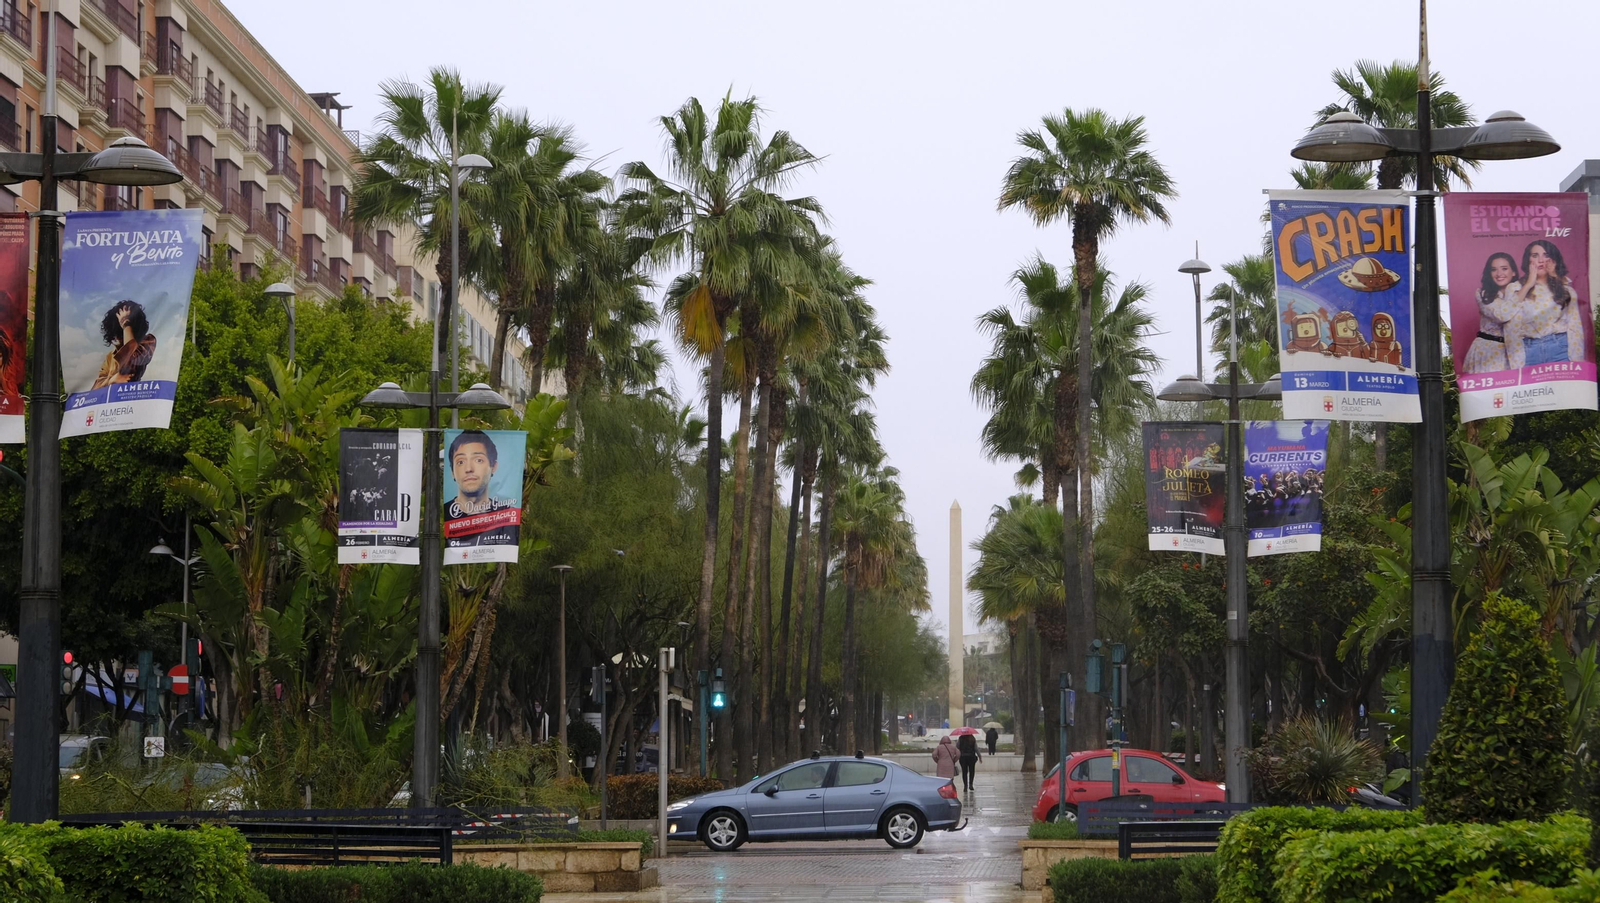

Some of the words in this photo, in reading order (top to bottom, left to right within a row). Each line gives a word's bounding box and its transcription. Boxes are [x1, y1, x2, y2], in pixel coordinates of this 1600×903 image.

[1470, 205, 1560, 218] ESTIRANDO
[1471, 218, 1490, 232] EL
[1496, 218, 1561, 232] CHICLE
[76, 230, 183, 247] FORTUNATA
[1545, 227, 1572, 237] LIVE
[1277, 208, 1405, 282] CRASH
[111, 253, 124, 269] y
[1530, 362, 1582, 375] ALMERÍA
[117, 381, 160, 392] ALMERÍA
[1294, 378, 1308, 388] 13
[1357, 375, 1404, 385] ALMERÍA
[1462, 378, 1494, 389] 12-13
[1512, 386, 1554, 399] ALMERÍA
[72, 397, 85, 408] 20
[1341, 397, 1382, 407] ALMERÍA
[100, 405, 134, 417] ALMERÍA
[1250, 452, 1322, 463] CURRENTS
[1164, 467, 1210, 480] ROMEO
[1163, 481, 1212, 494] JULIETA
[374, 510, 397, 521] CARA
[400, 493, 410, 522] B
[465, 501, 491, 513] David
[492, 496, 517, 510] Guapo
[449, 520, 470, 529] NUEVO
[472, 511, 516, 524] ESPECTÁCULO
